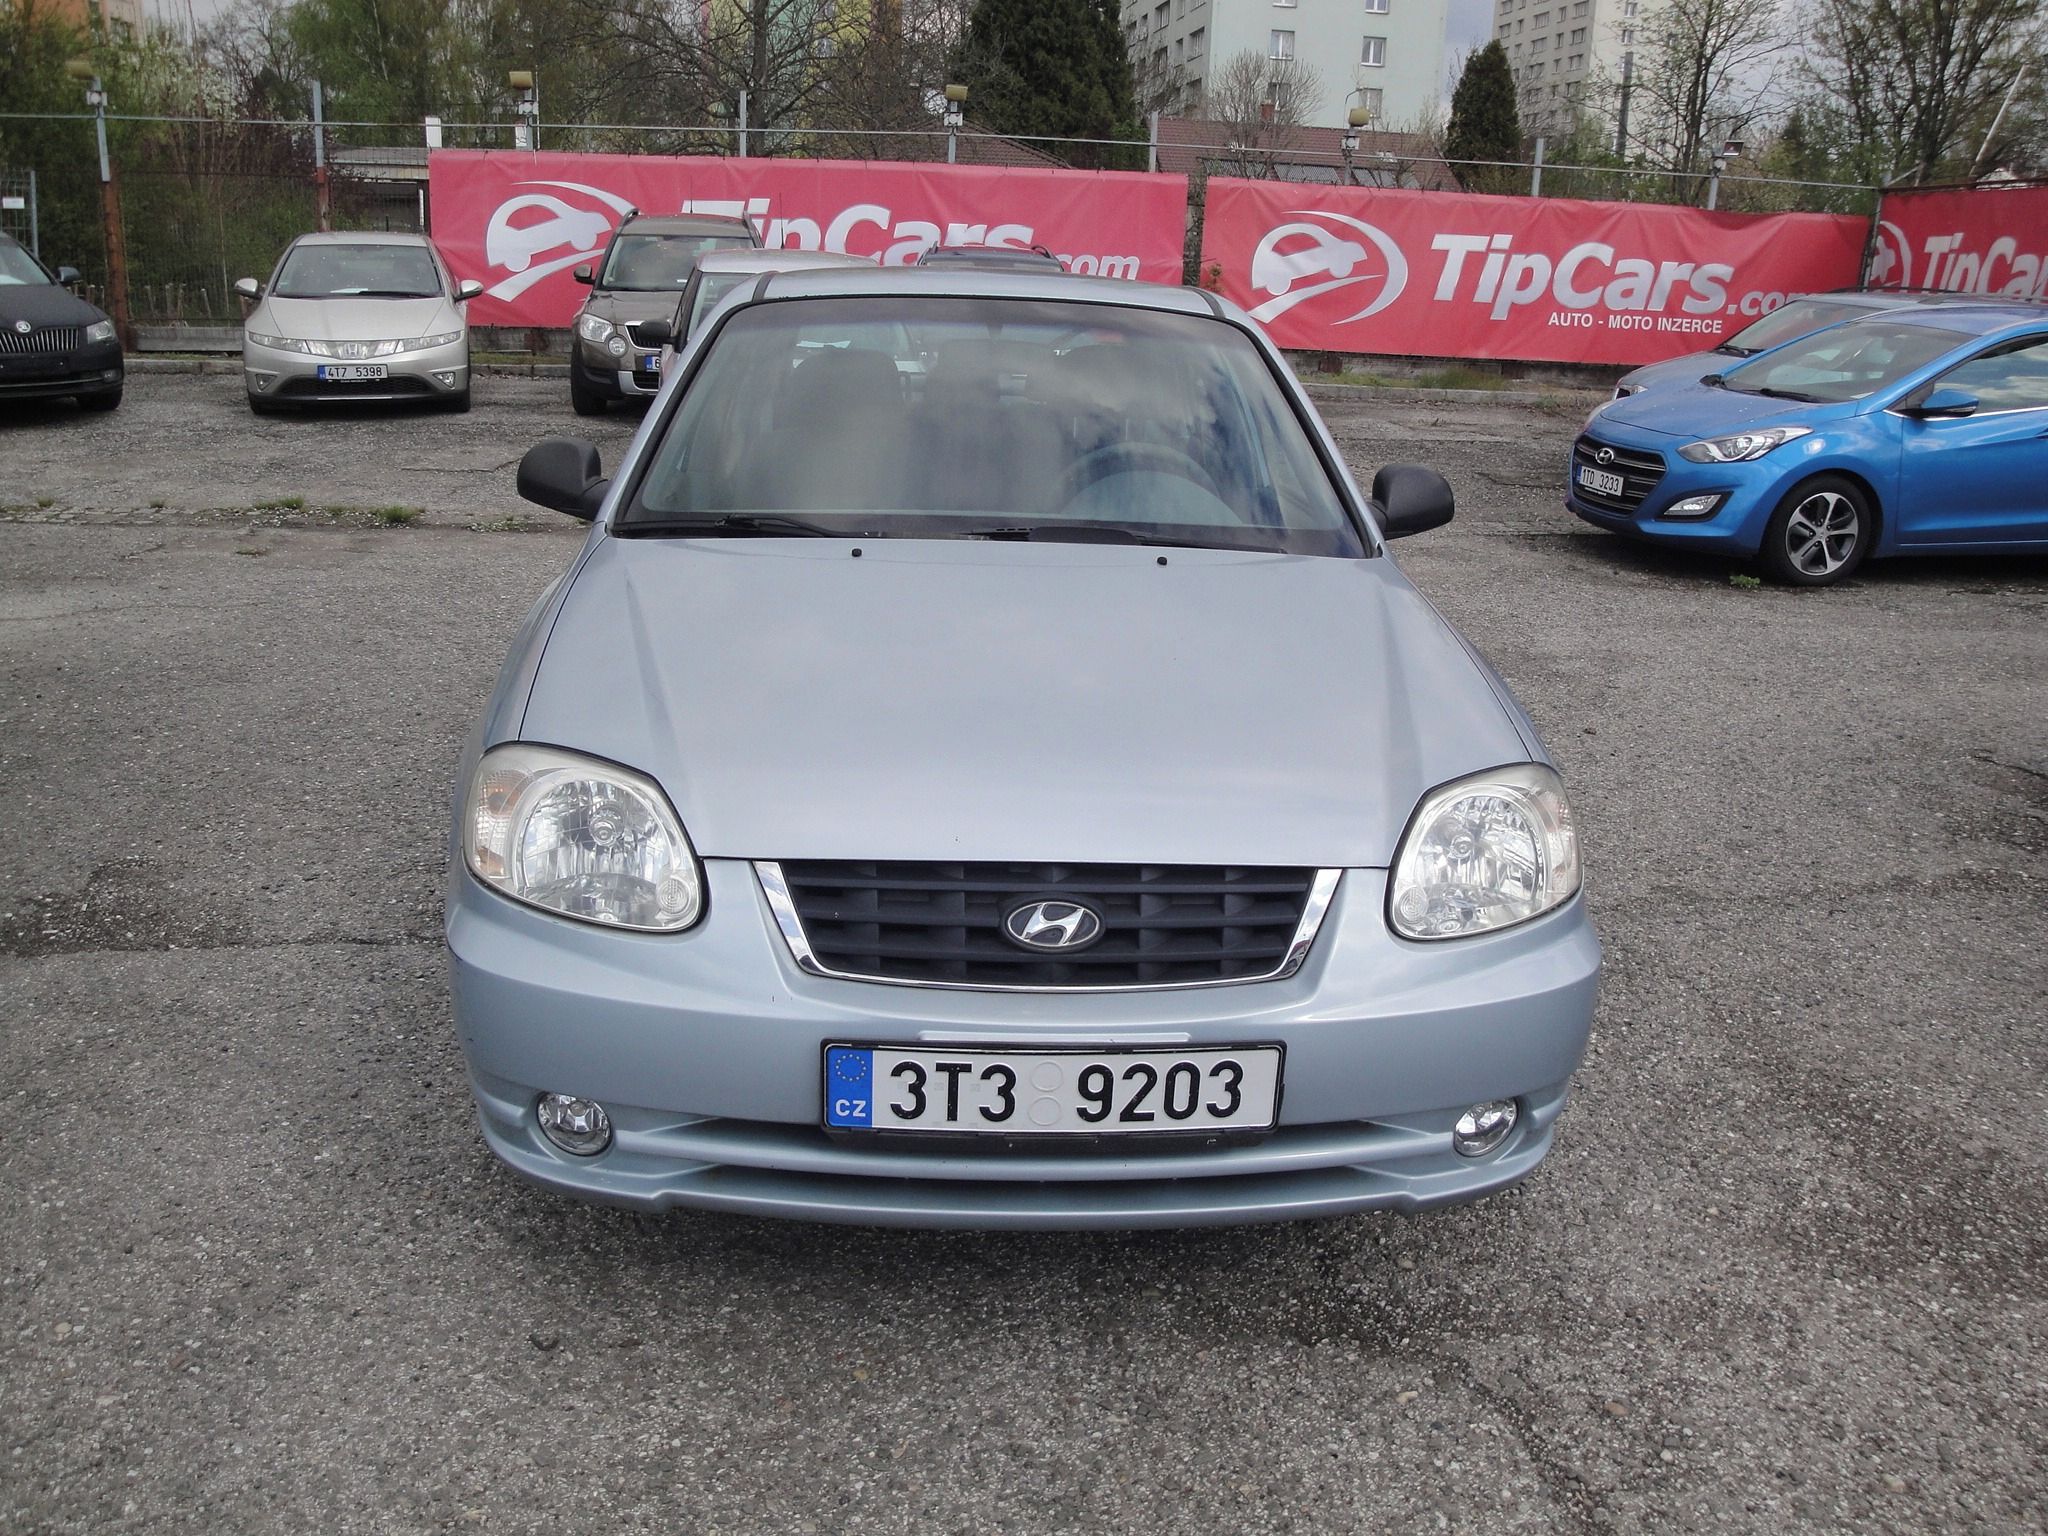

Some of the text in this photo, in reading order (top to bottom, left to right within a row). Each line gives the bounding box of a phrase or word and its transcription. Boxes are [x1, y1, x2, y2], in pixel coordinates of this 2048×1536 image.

[1548, 312, 1593, 328] AUTO
[1608, 315, 1653, 331] MOTO
[1657, 318, 1722, 334] INZERCE
[328, 367, 347, 377] 4T7
[355, 367, 382, 377] 5398
[1599, 474, 1619, 492] 3233
[890, 1060, 1244, 1123] 3T3 9203
[835, 1099, 866, 1117] CZ
